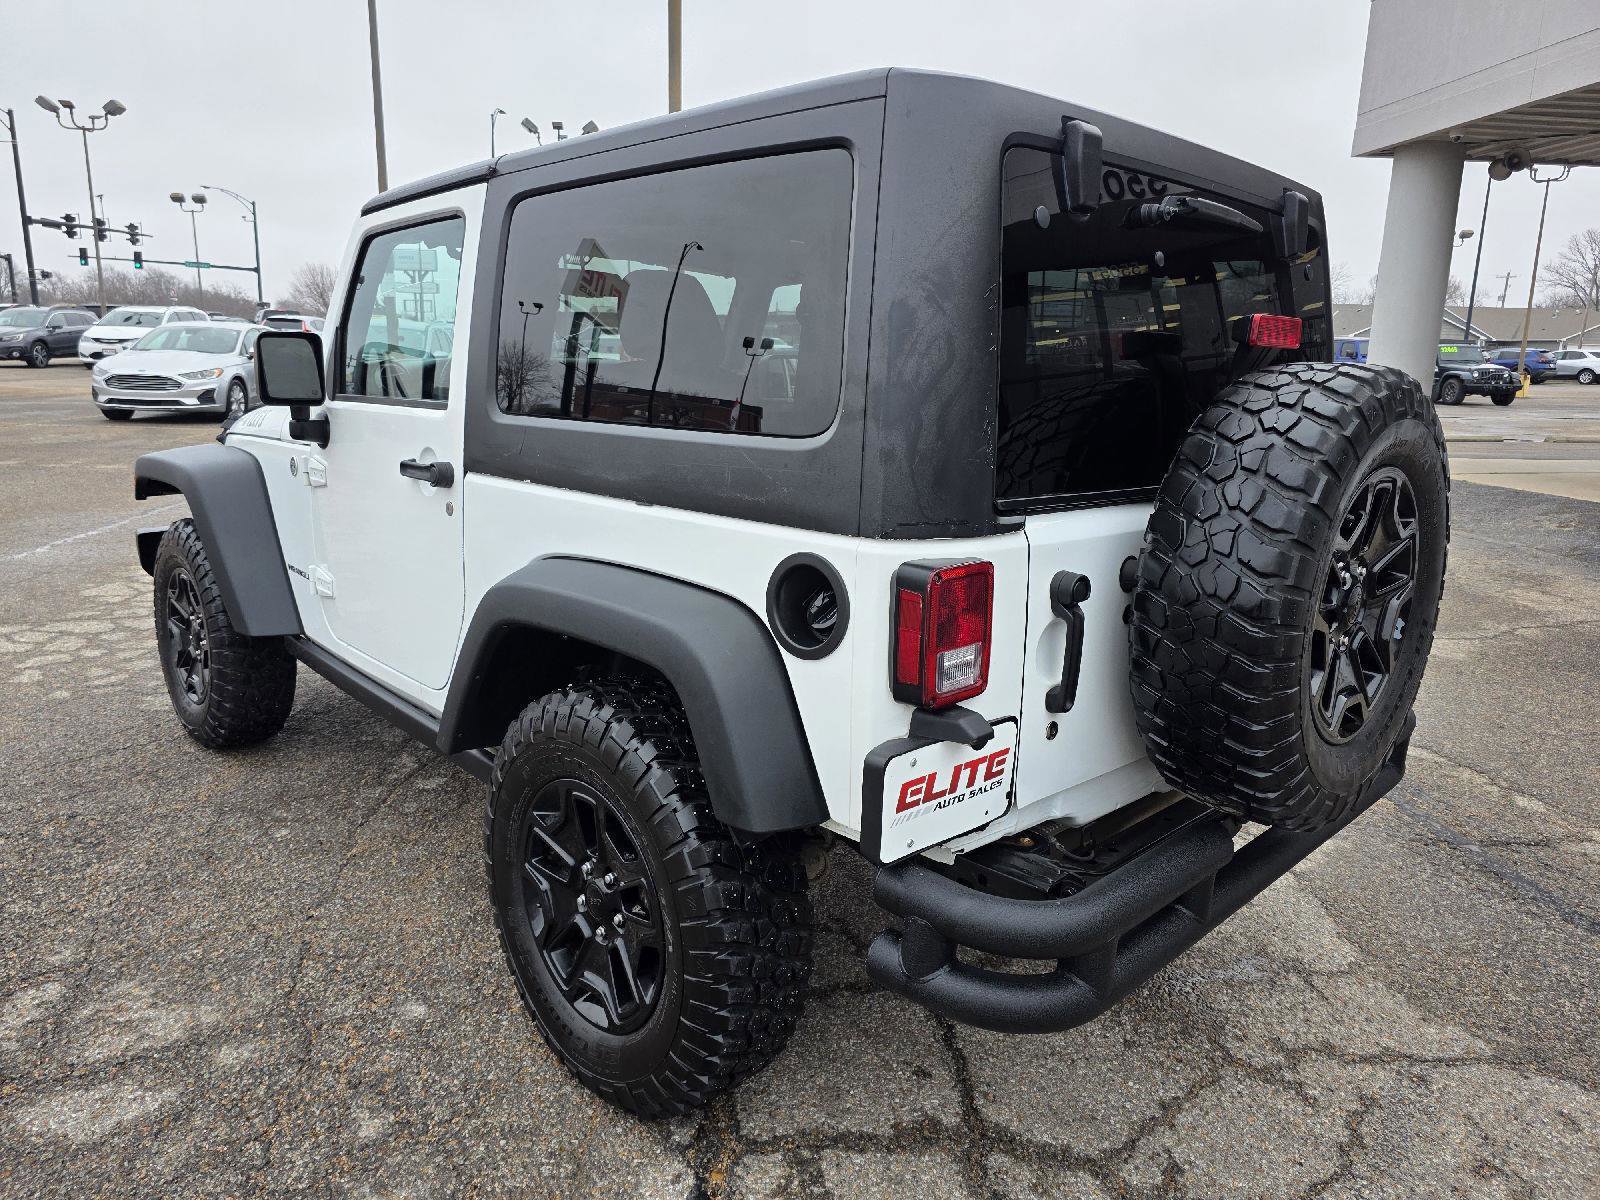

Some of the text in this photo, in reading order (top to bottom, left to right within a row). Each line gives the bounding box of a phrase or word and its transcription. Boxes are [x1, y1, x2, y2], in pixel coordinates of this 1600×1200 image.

[895, 747, 1011, 815] ELITE
[933, 778, 1003, 812] AUTO SALES
